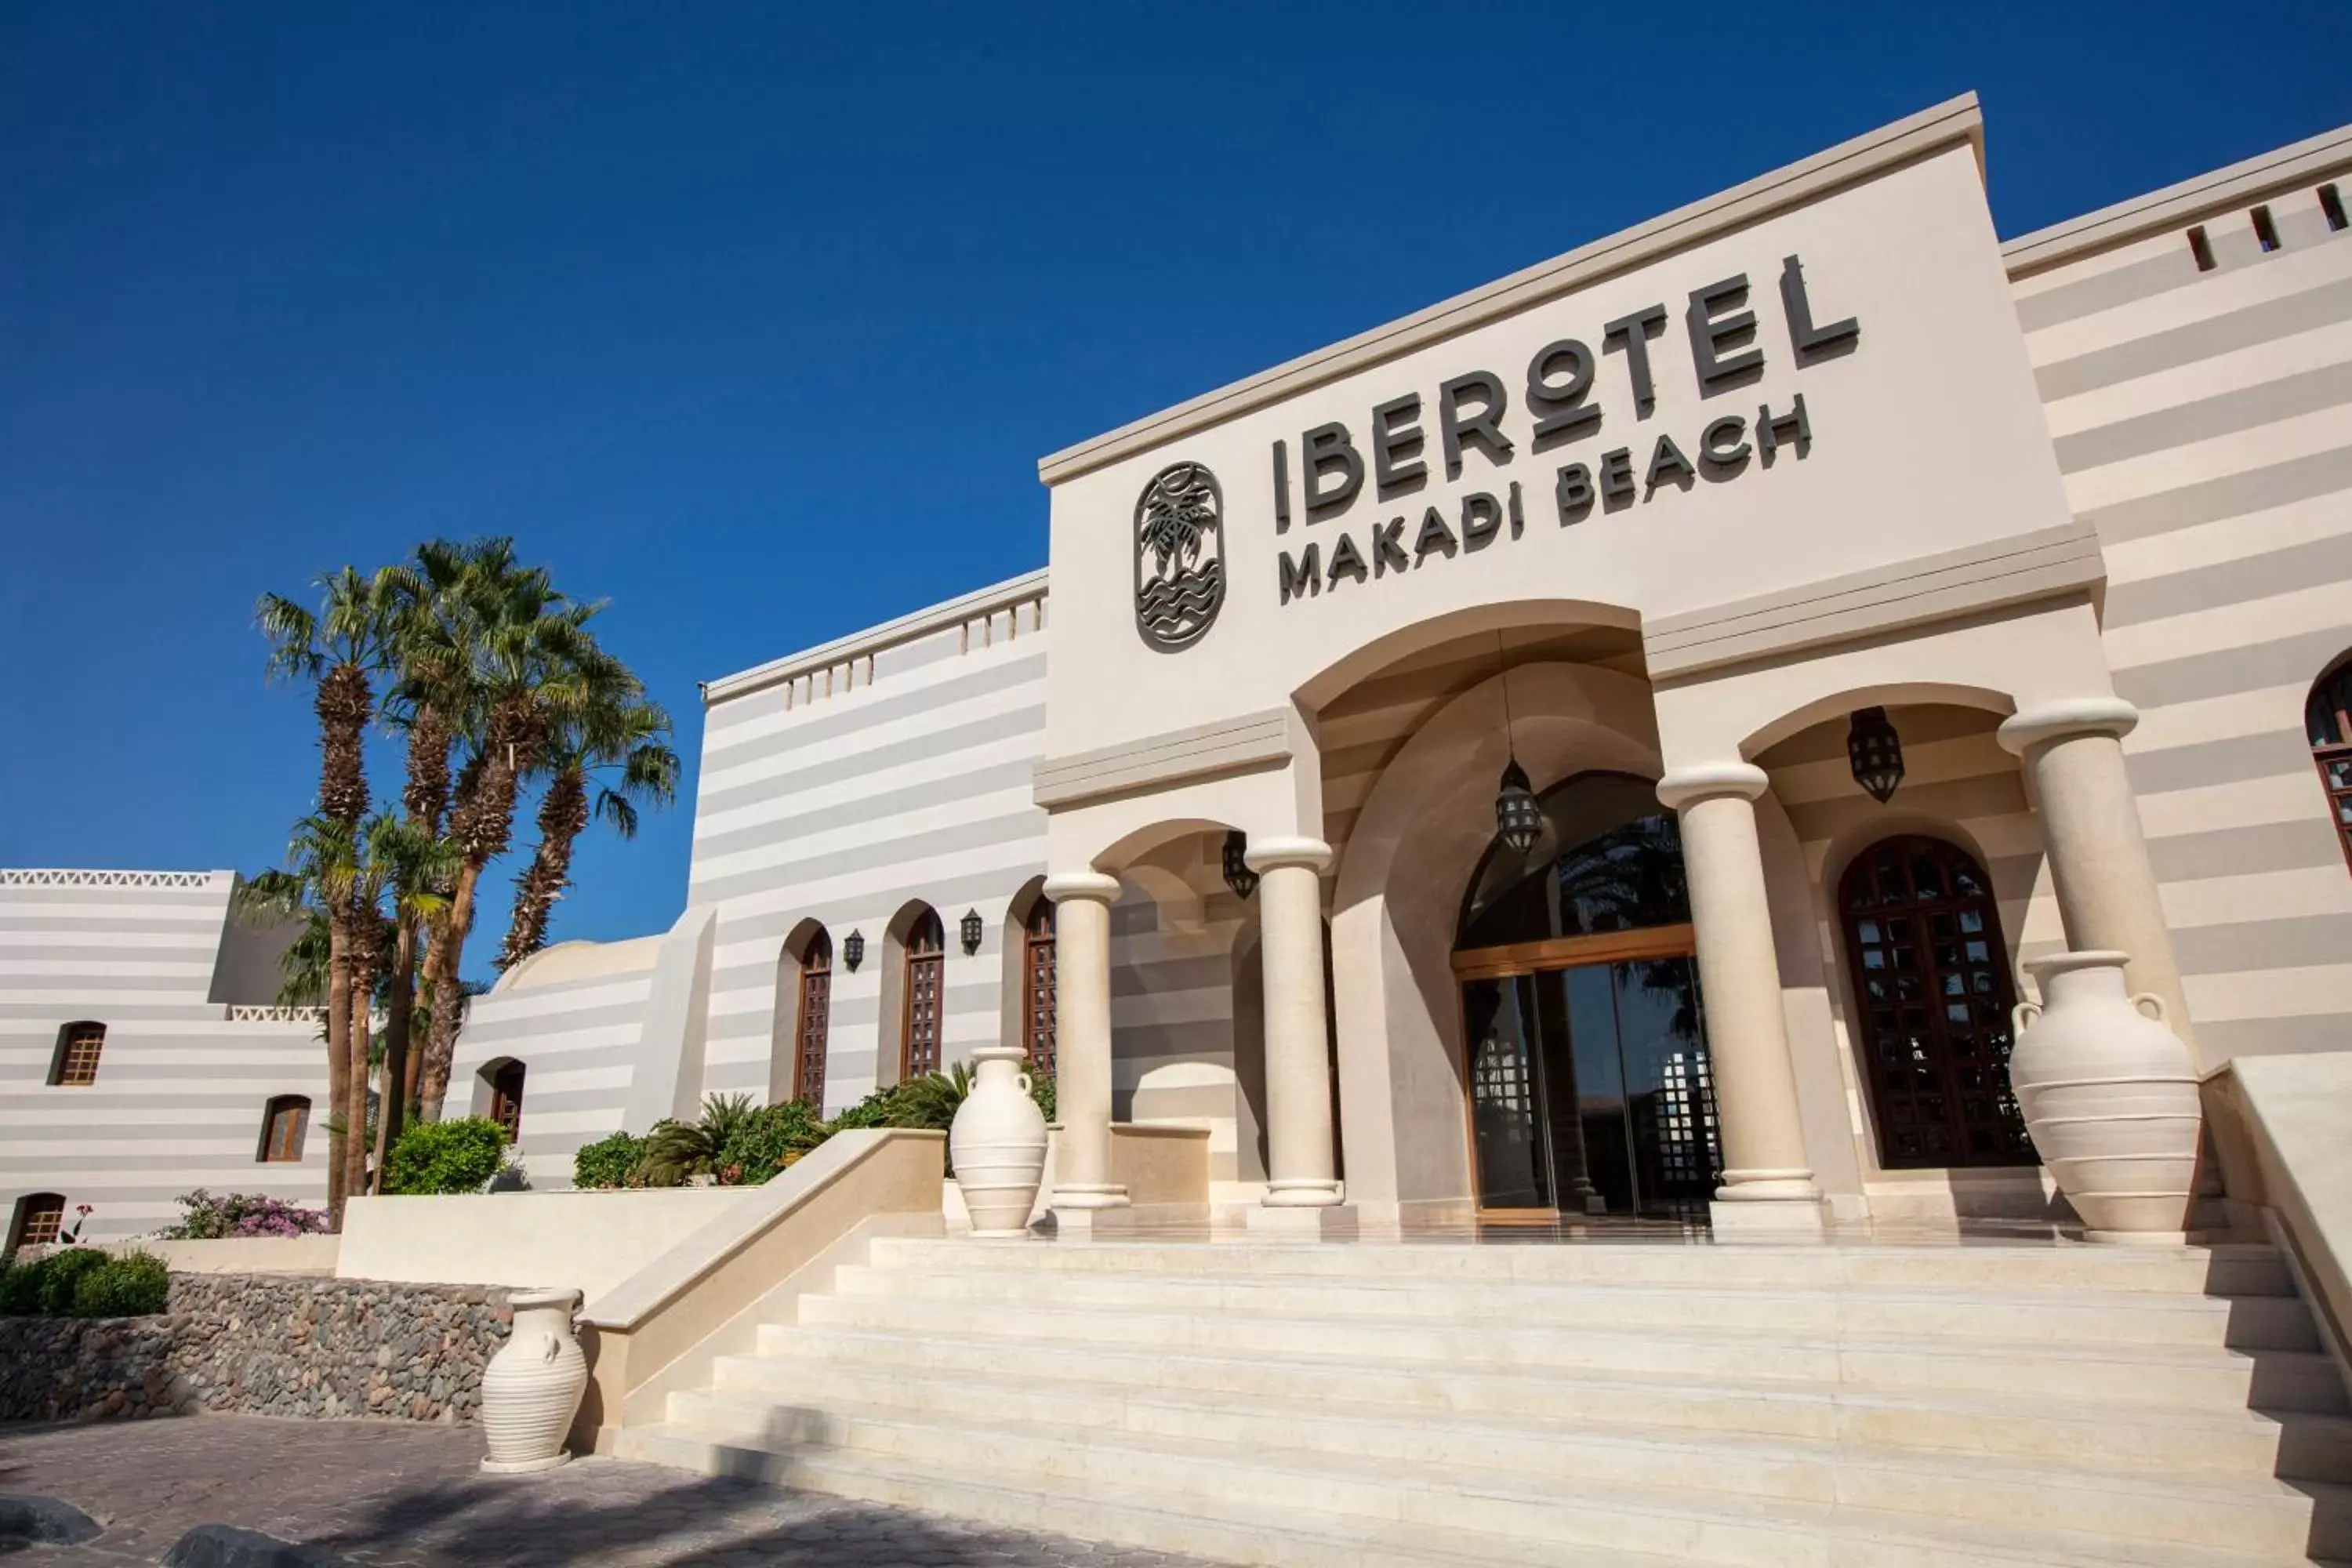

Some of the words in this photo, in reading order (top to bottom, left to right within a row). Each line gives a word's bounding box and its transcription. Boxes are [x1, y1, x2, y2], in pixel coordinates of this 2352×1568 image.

[1272, 254, 1860, 527] IBEROTEL
[1279, 481, 1524, 601] MAKADI
[1556, 393, 1812, 518] BEACH
